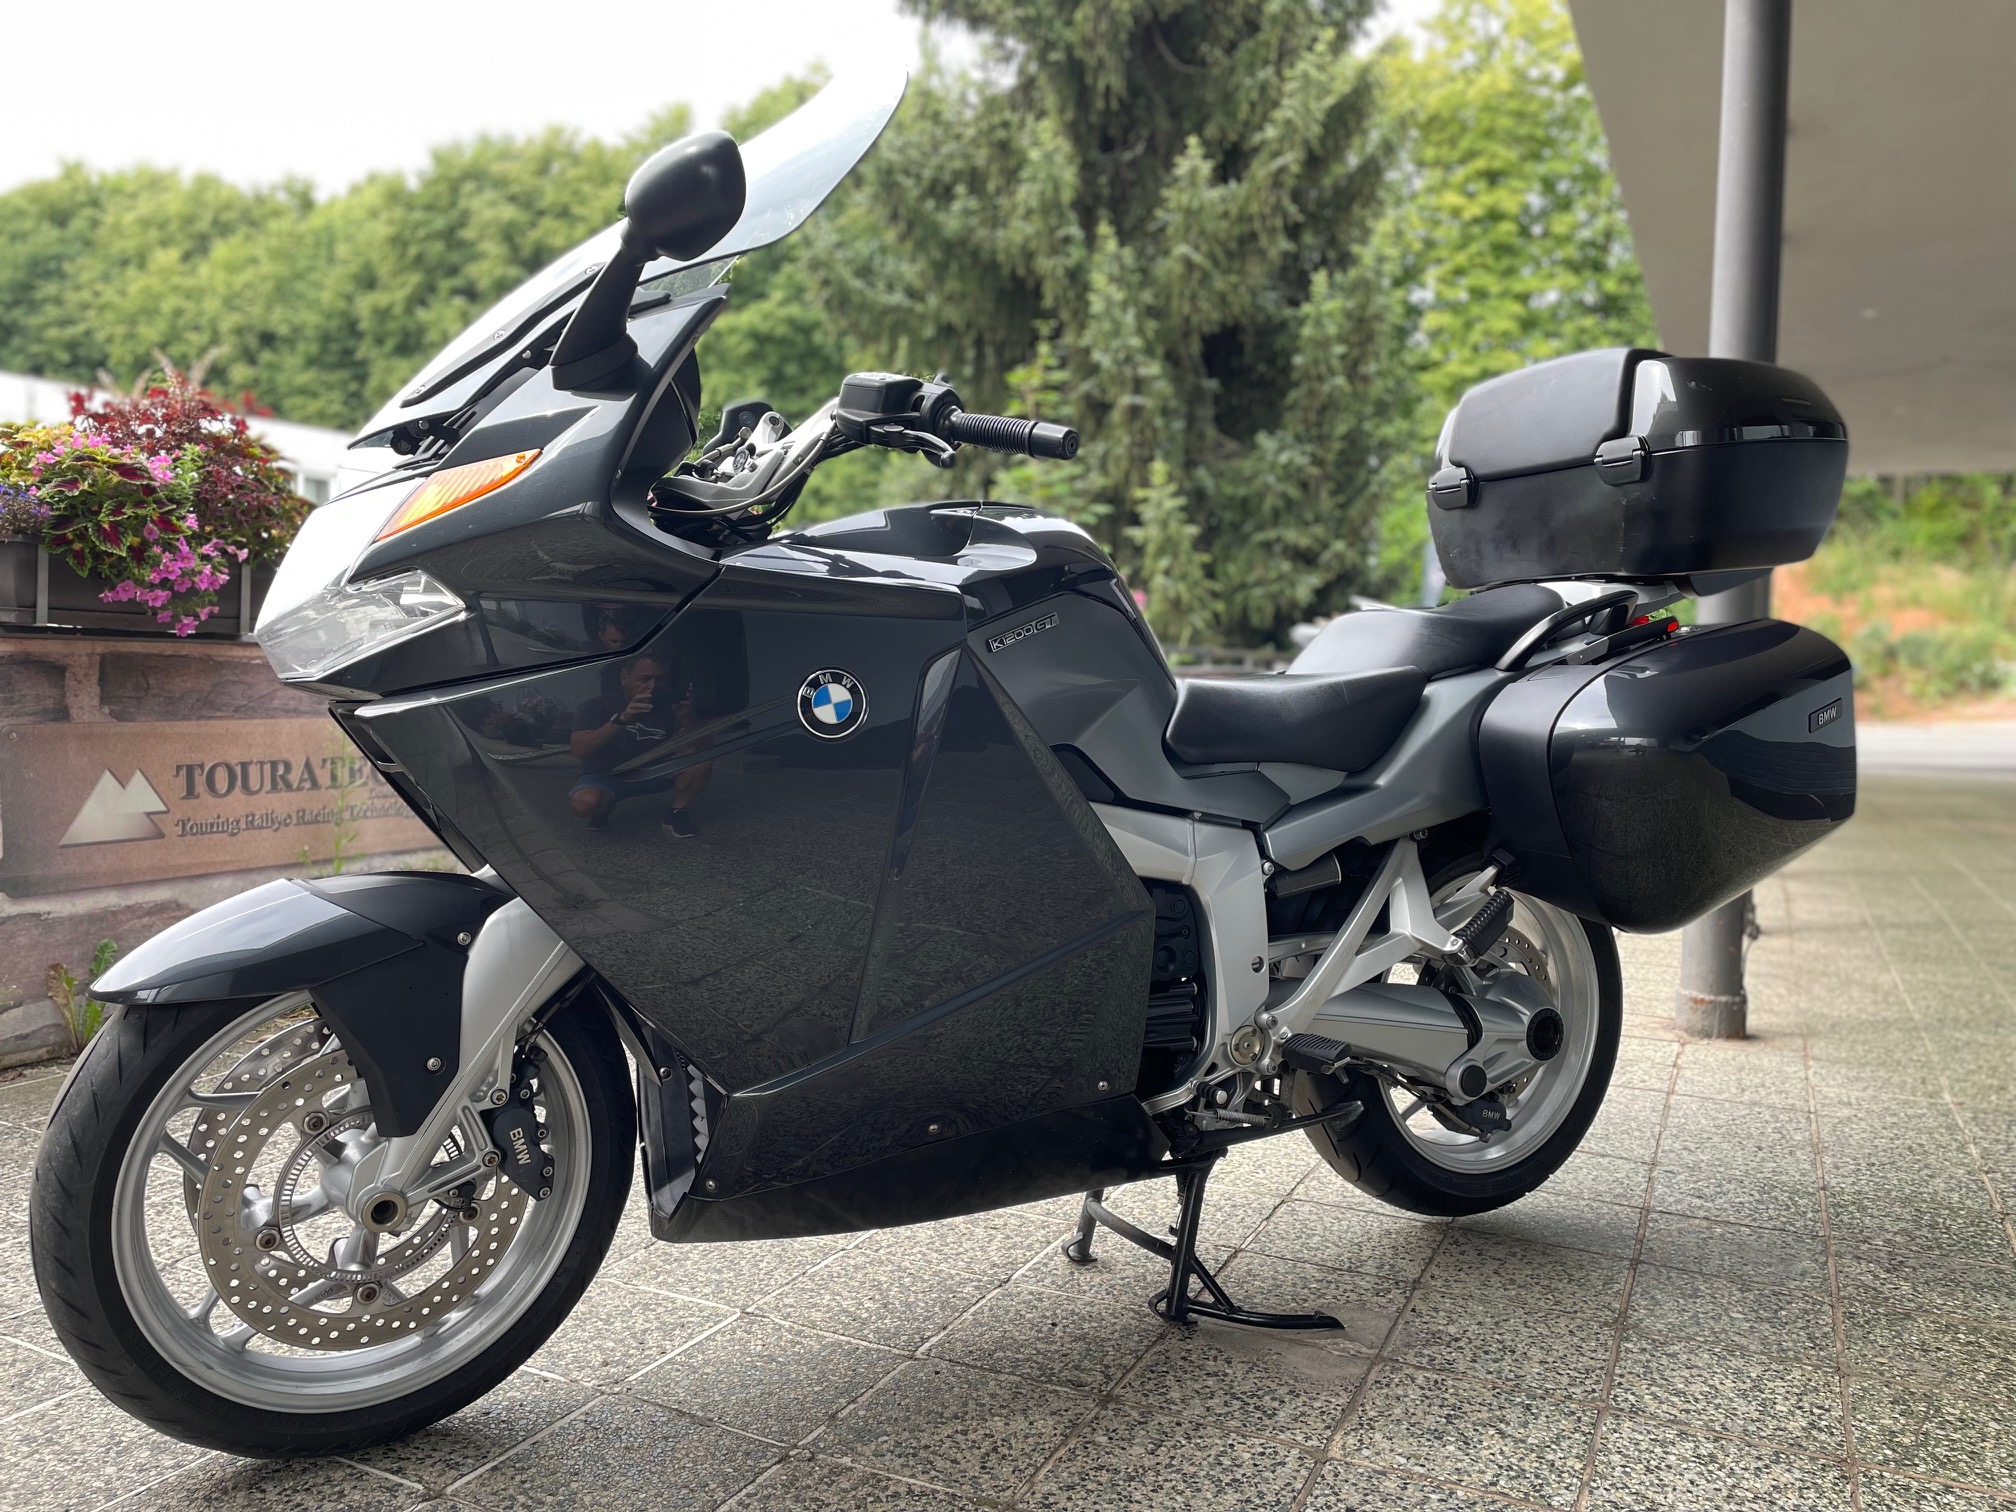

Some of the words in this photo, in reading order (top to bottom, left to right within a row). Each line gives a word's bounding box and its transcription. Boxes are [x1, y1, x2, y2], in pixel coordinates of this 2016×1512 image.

[802, 672, 854, 699] BMW
[1817, 706, 1837, 725] BMW
[175, 814, 241, 837] Touring
[242, 809, 293, 832] Rallye
[1482, 1109, 1501, 1120] BMW
[509, 1127, 531, 1165] BMW
